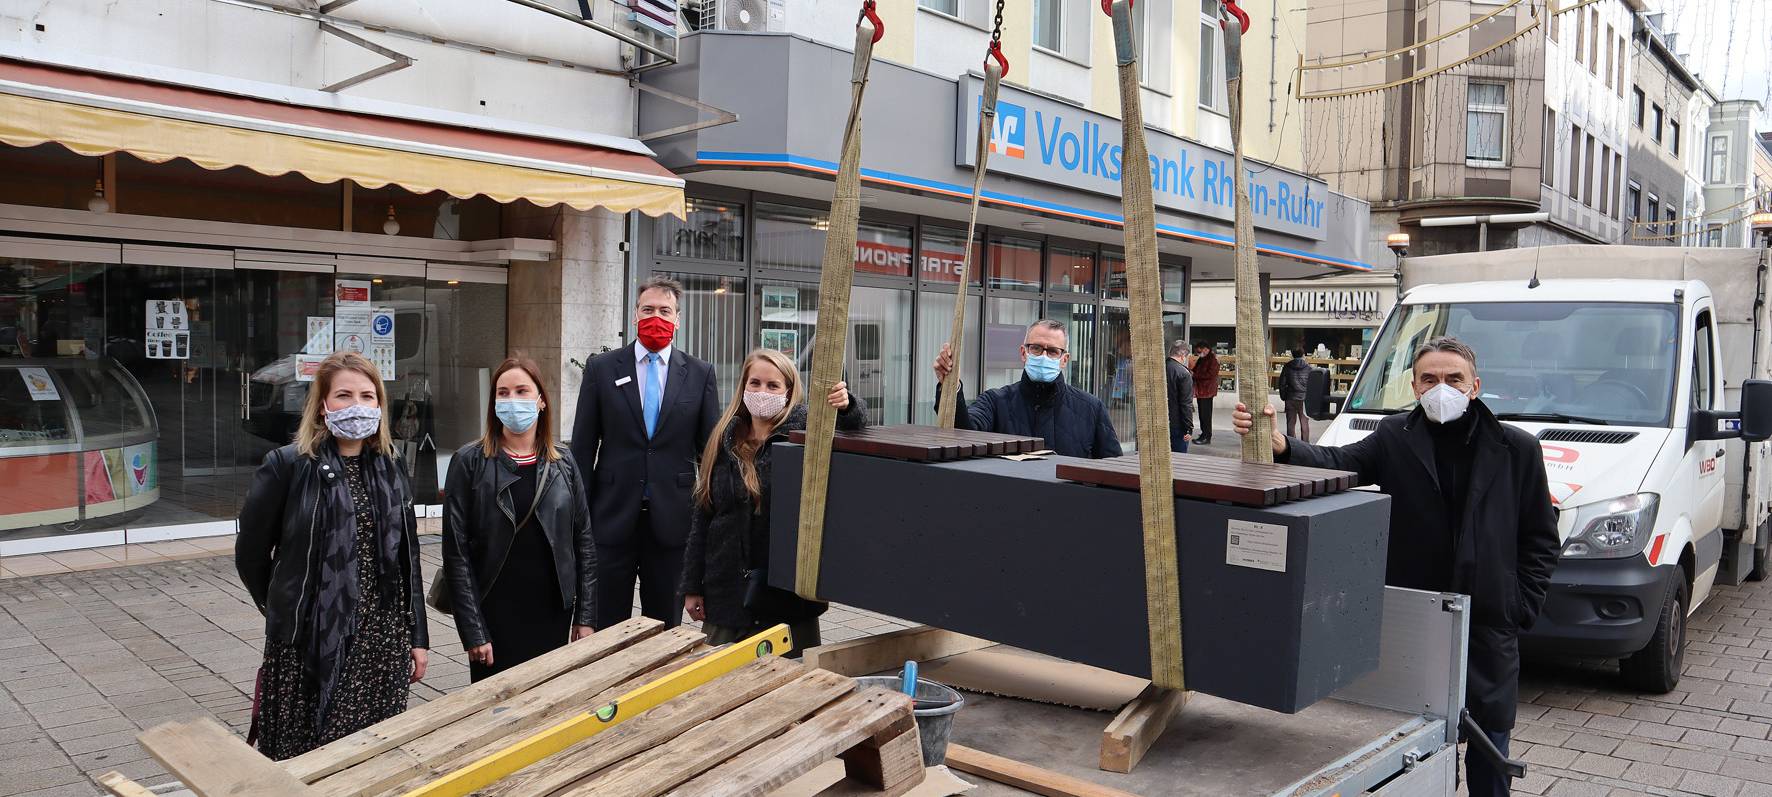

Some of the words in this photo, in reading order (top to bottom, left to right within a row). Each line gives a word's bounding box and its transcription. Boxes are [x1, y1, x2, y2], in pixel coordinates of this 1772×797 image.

[1034, 111, 1196, 200] Volksank
[1203, 159, 1325, 229] Rhin-Ruhr
[1269, 291, 1378, 312] CHMIEMANN
